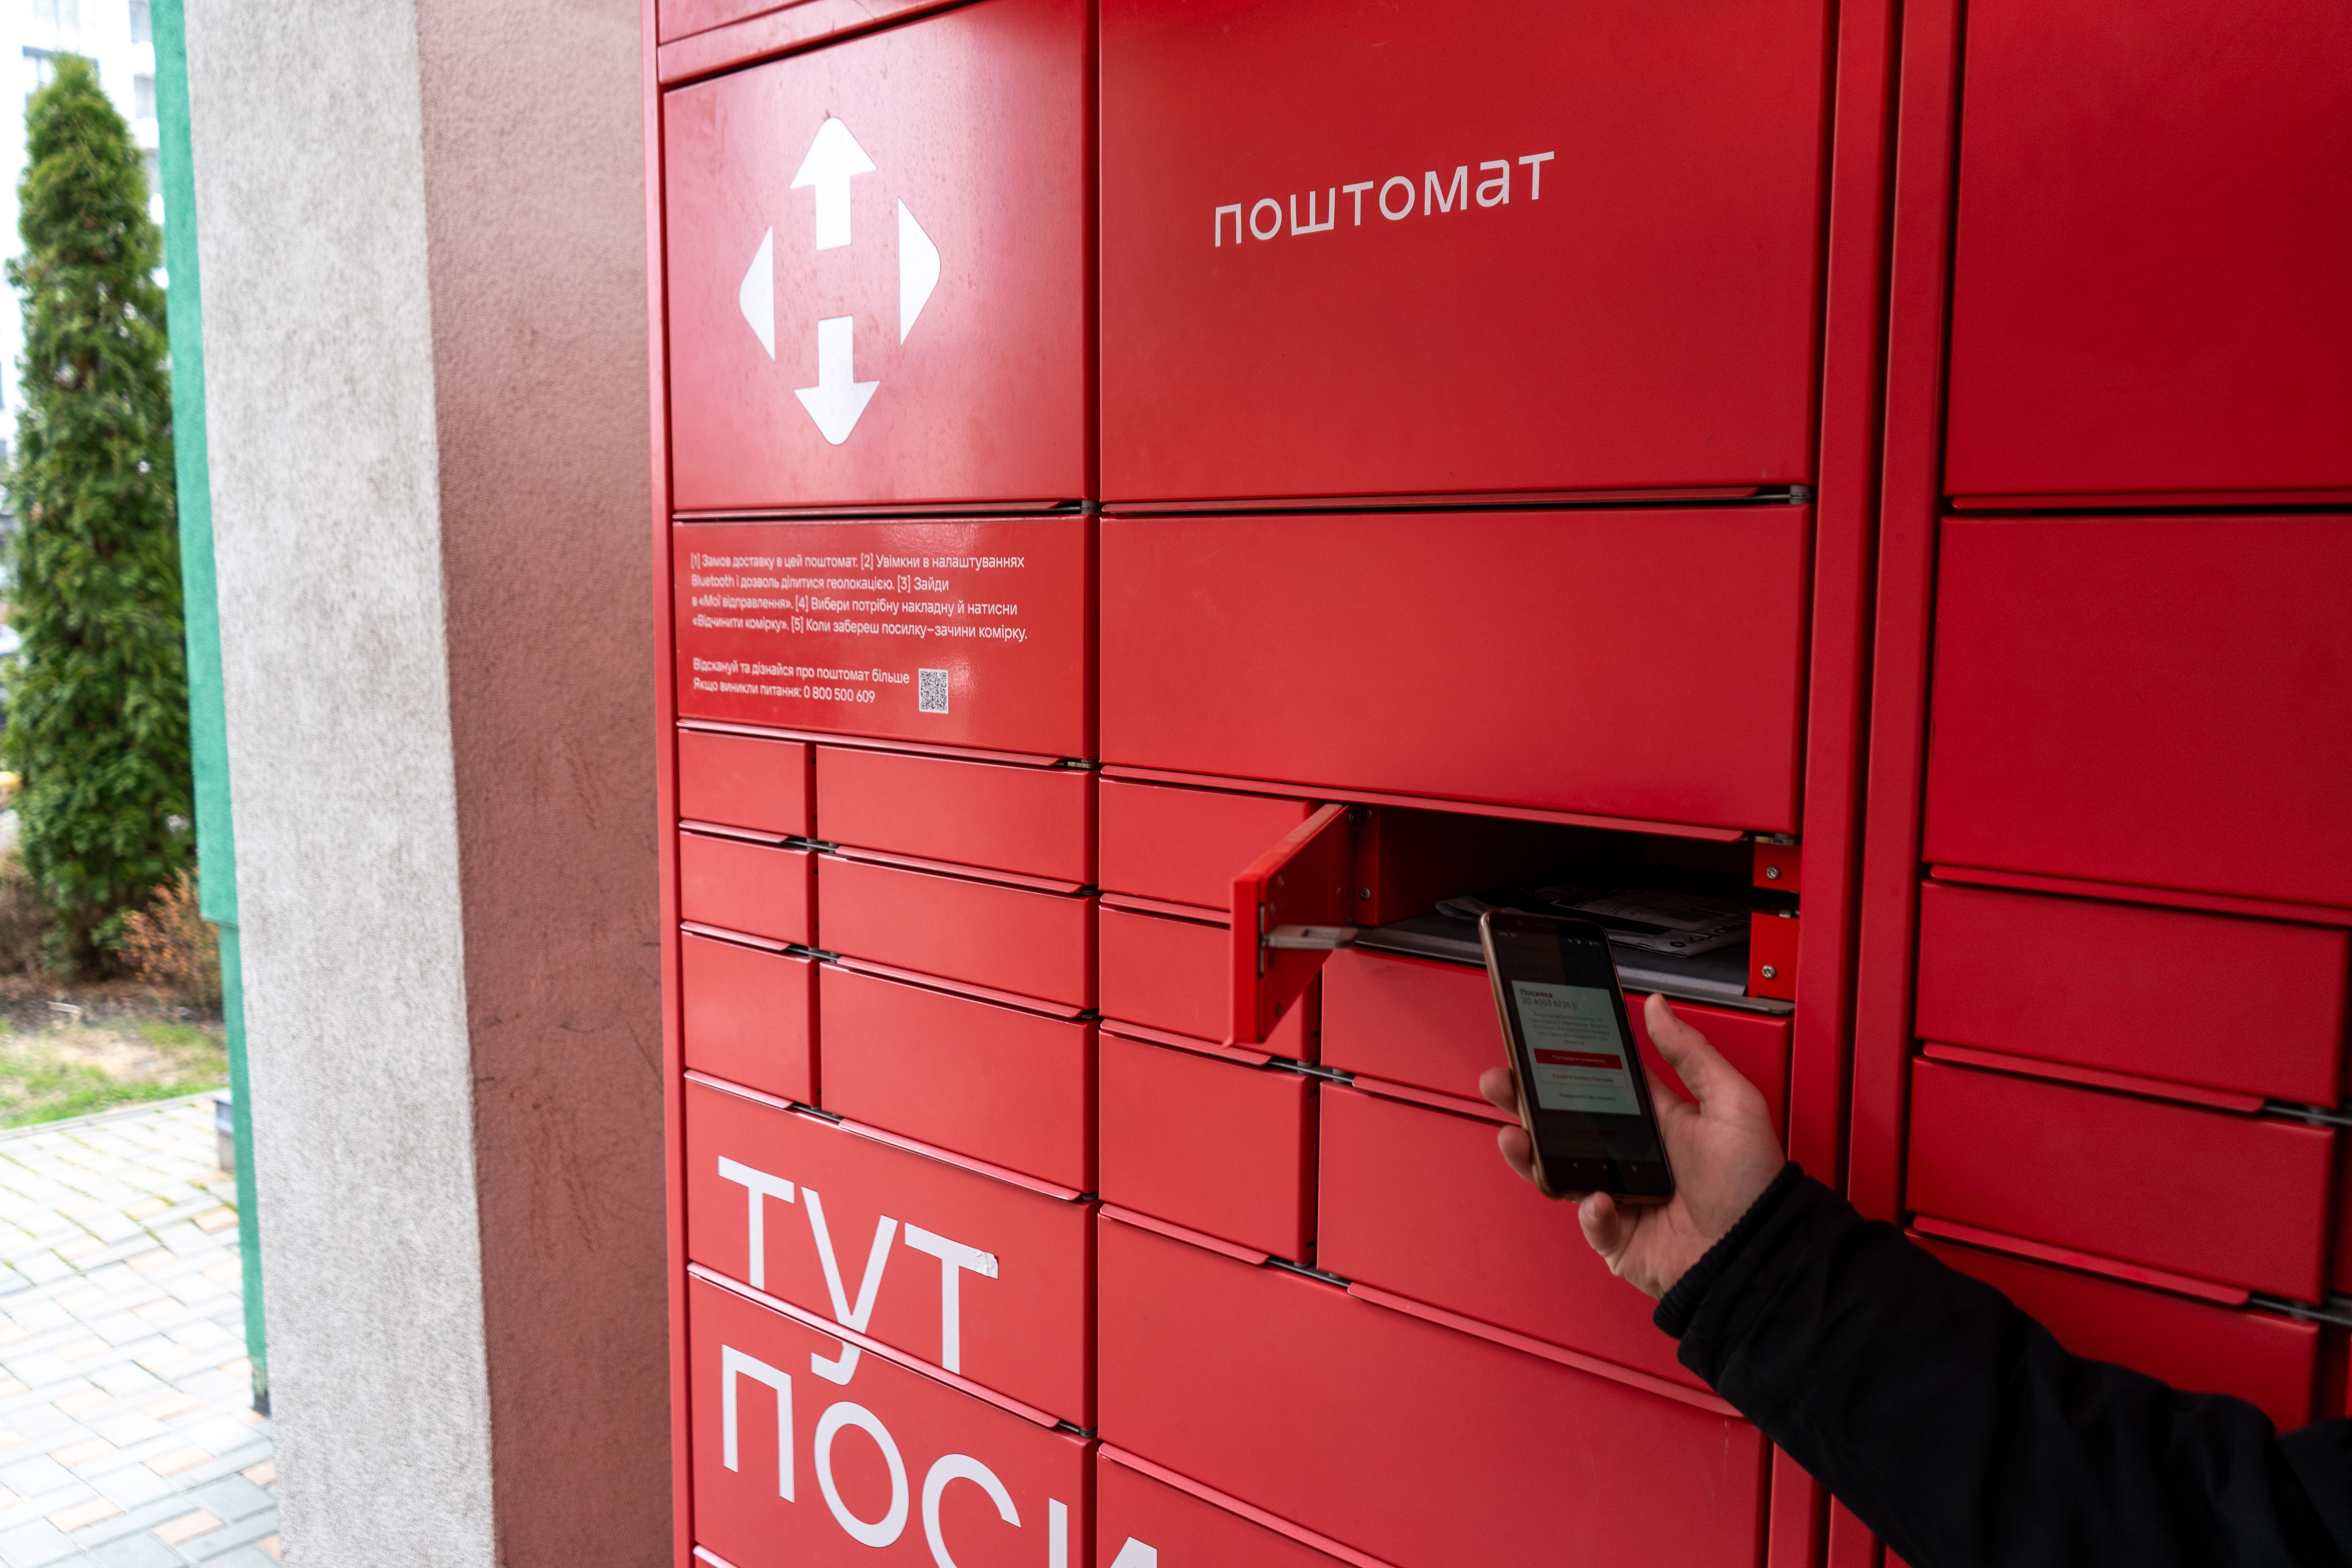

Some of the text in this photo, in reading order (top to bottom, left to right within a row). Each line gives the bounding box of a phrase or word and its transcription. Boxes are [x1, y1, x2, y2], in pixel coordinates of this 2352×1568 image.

[1215, 151, 1555, 247] поштомат
[690, 552, 1025, 571] [1] Замов доставку в цей поштомат. [2] Увімкни в налаштуваннях
[691, 574, 949, 593] Bluetooth і дозволь ділитися геолокацією. [3] Зайди
[691, 596, 698, 606] в
[699, 594, 721, 606] «Мої
[795, 594, 808, 612] [4]
[811, 597, 849, 613] Вибери
[852, 598, 899, 615] потрібну
[902, 602, 955, 617] накладну
[958, 600, 964, 613] й
[967, 603, 1017, 615] натисни
[744, 616, 789, 633] комірку».
[791, 615, 804, 633] [5]
[806, 618, 831, 632] Коли
[833, 619, 879, 636] забереш
[979, 624, 1027, 642] комірку.
[693, 657, 910, 684] Відскануй та дізнайся про поштомат більше
[693, 677, 875, 703] Якщо виникли питання: 0 800 500 609
[1520, 989, 1553, 998] Посилка
[1534, 998, 1552, 1007] 4003
